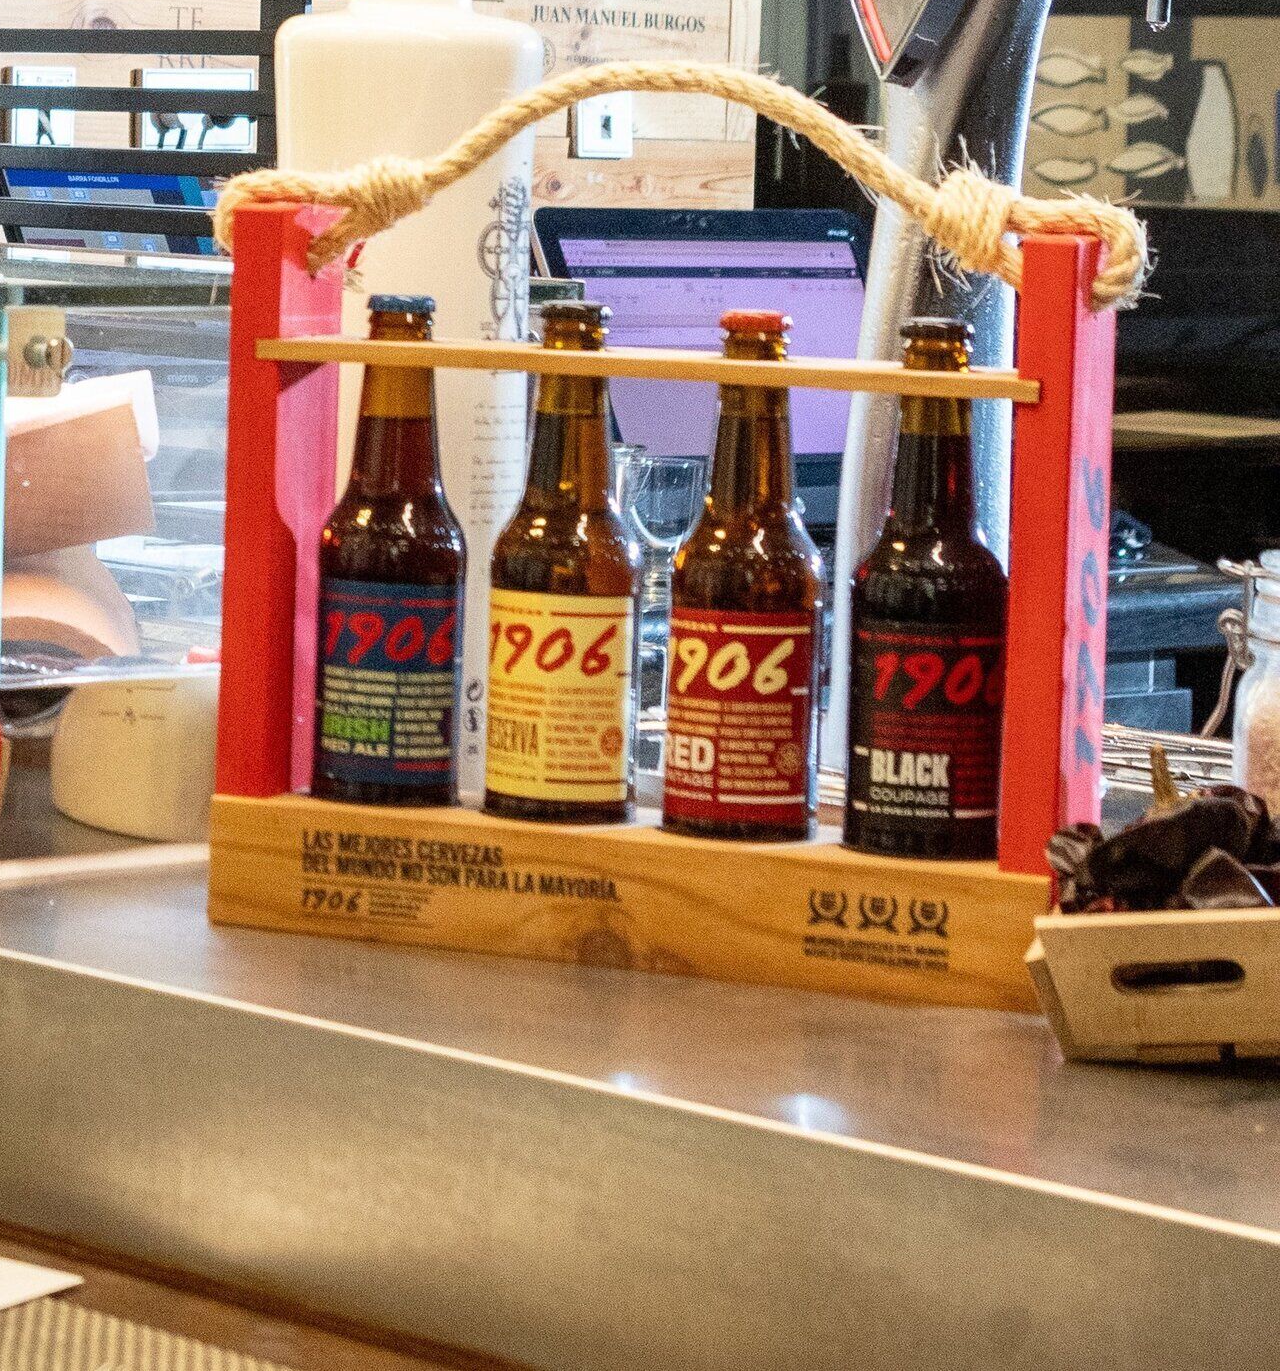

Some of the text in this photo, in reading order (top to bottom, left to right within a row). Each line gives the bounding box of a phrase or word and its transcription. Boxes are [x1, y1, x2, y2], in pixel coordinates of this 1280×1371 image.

[531, 4, 707, 34] JUAN MANUEL BURGOS
[325, 609, 457, 666] 1906
[353, 742, 391, 758] ALE
[869, 747, 951, 789] BLACK
[869, 785, 951, 807] COUPAGE
[301, 829, 504, 868] LAS MEJORES CERVEZAS
[301, 851, 332, 874] DEL
[336, 855, 399, 880] MUNDO
[400, 861, 425, 881] NO
[426, 863, 462, 887] SON
[463, 866, 510, 891] PARA
[512, 871, 536, 894] LA
[301, 887, 362, 913] 1906
